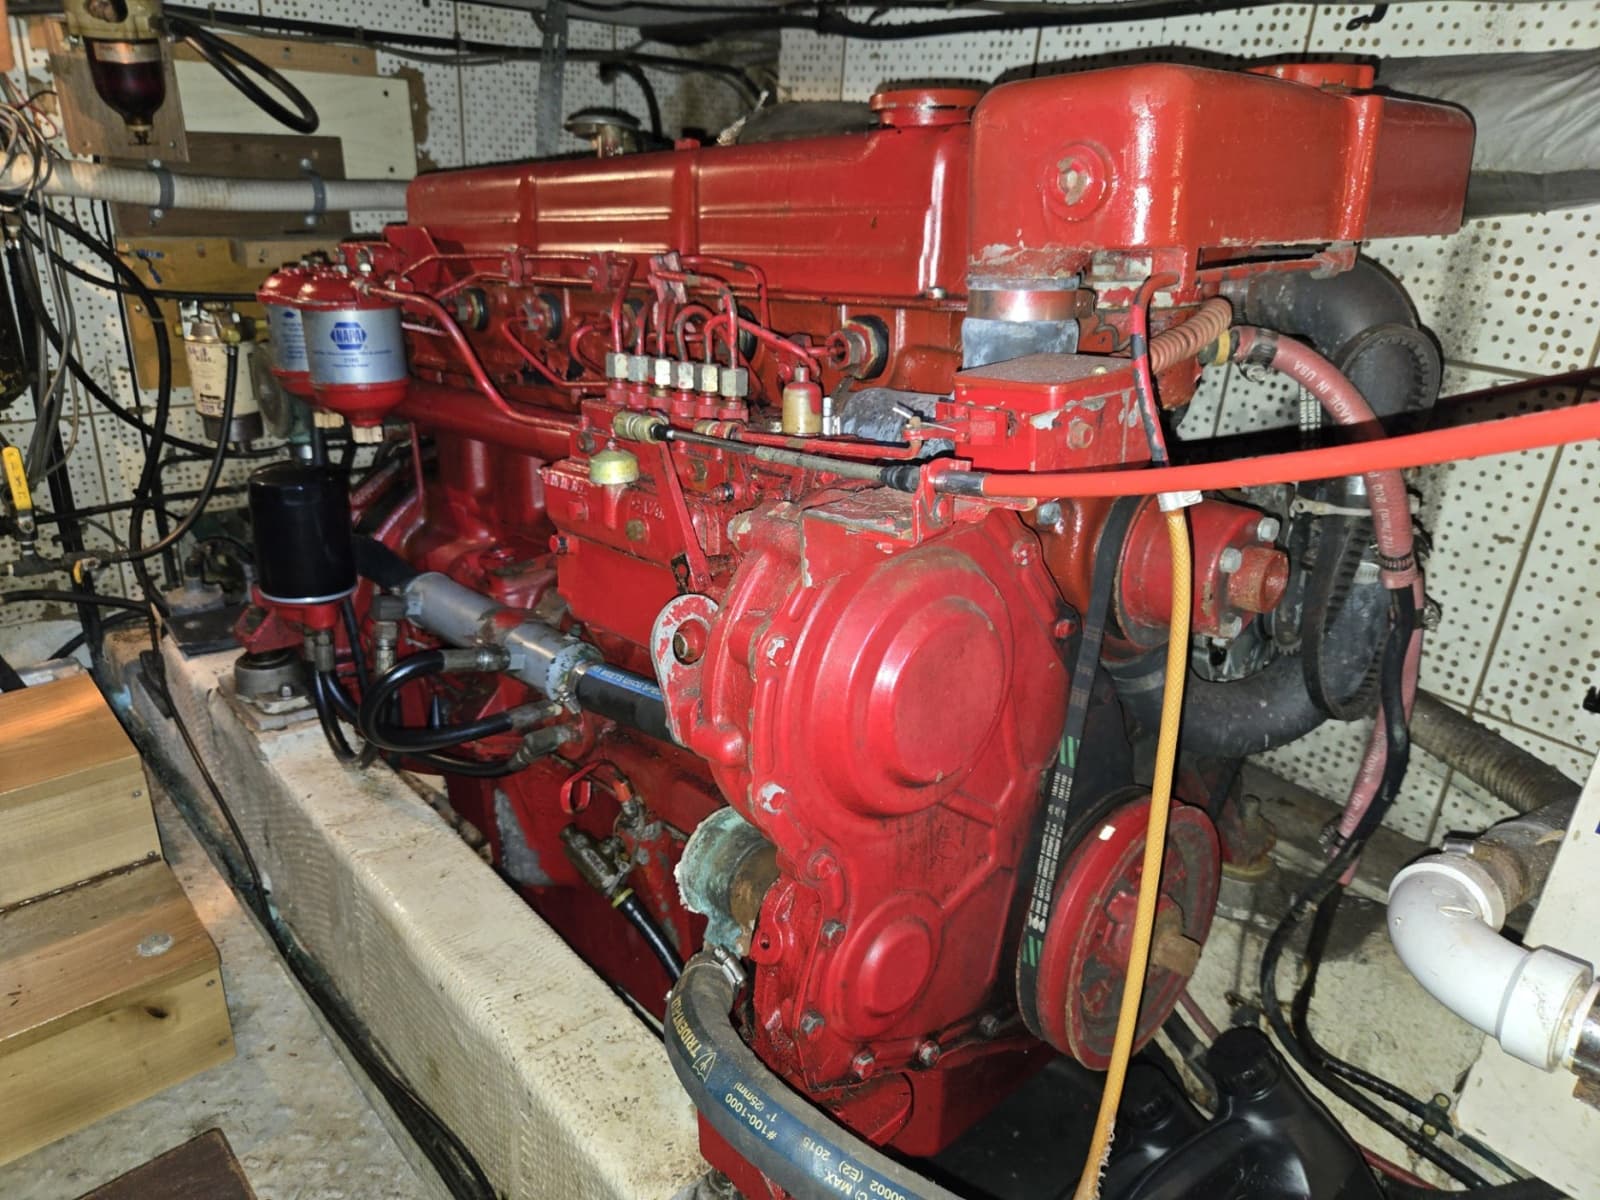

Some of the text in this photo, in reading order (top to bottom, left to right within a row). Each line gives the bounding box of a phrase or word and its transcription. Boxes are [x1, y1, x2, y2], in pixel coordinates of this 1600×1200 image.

[334, 328, 362, 344] NAPA
[1317, 380, 1329, 394] IN
[1330, 396, 1354, 425] MADE
[1375, 482, 1386, 503] 200
[725, 1093, 777, 1140] #100-1000
[802, 1136, 831, 1161] 2015
[839, 1160, 864, 1183] (E2)
